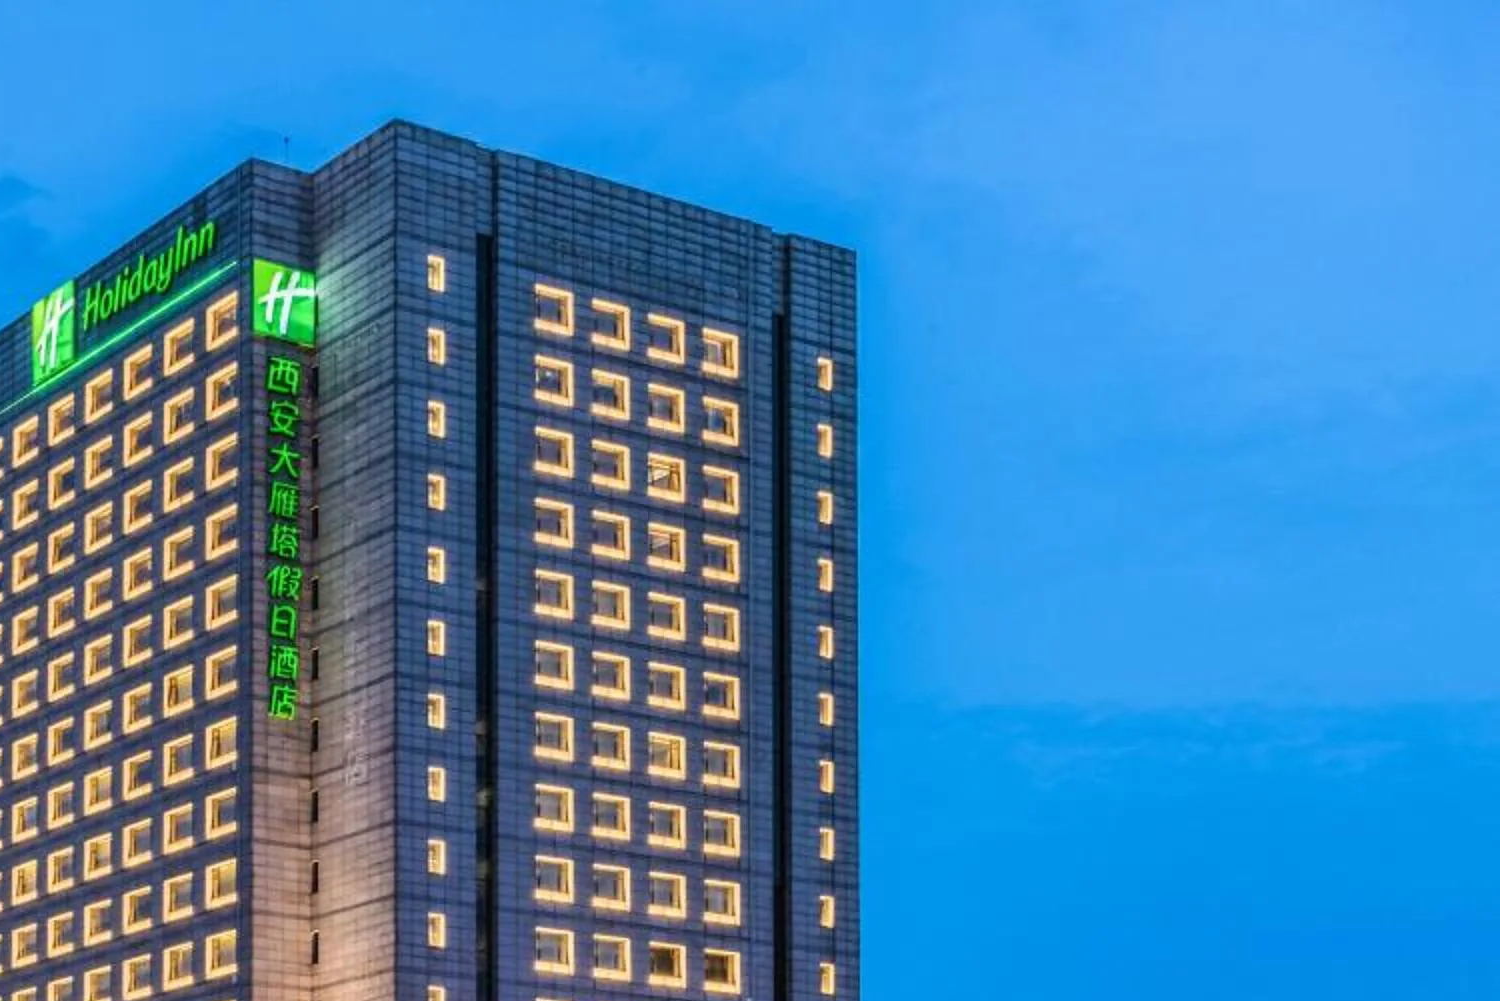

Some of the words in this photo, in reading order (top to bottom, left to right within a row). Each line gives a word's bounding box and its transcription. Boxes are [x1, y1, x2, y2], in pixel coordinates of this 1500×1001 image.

[266, 356, 303, 721] 西安大雁塔假日酒店
